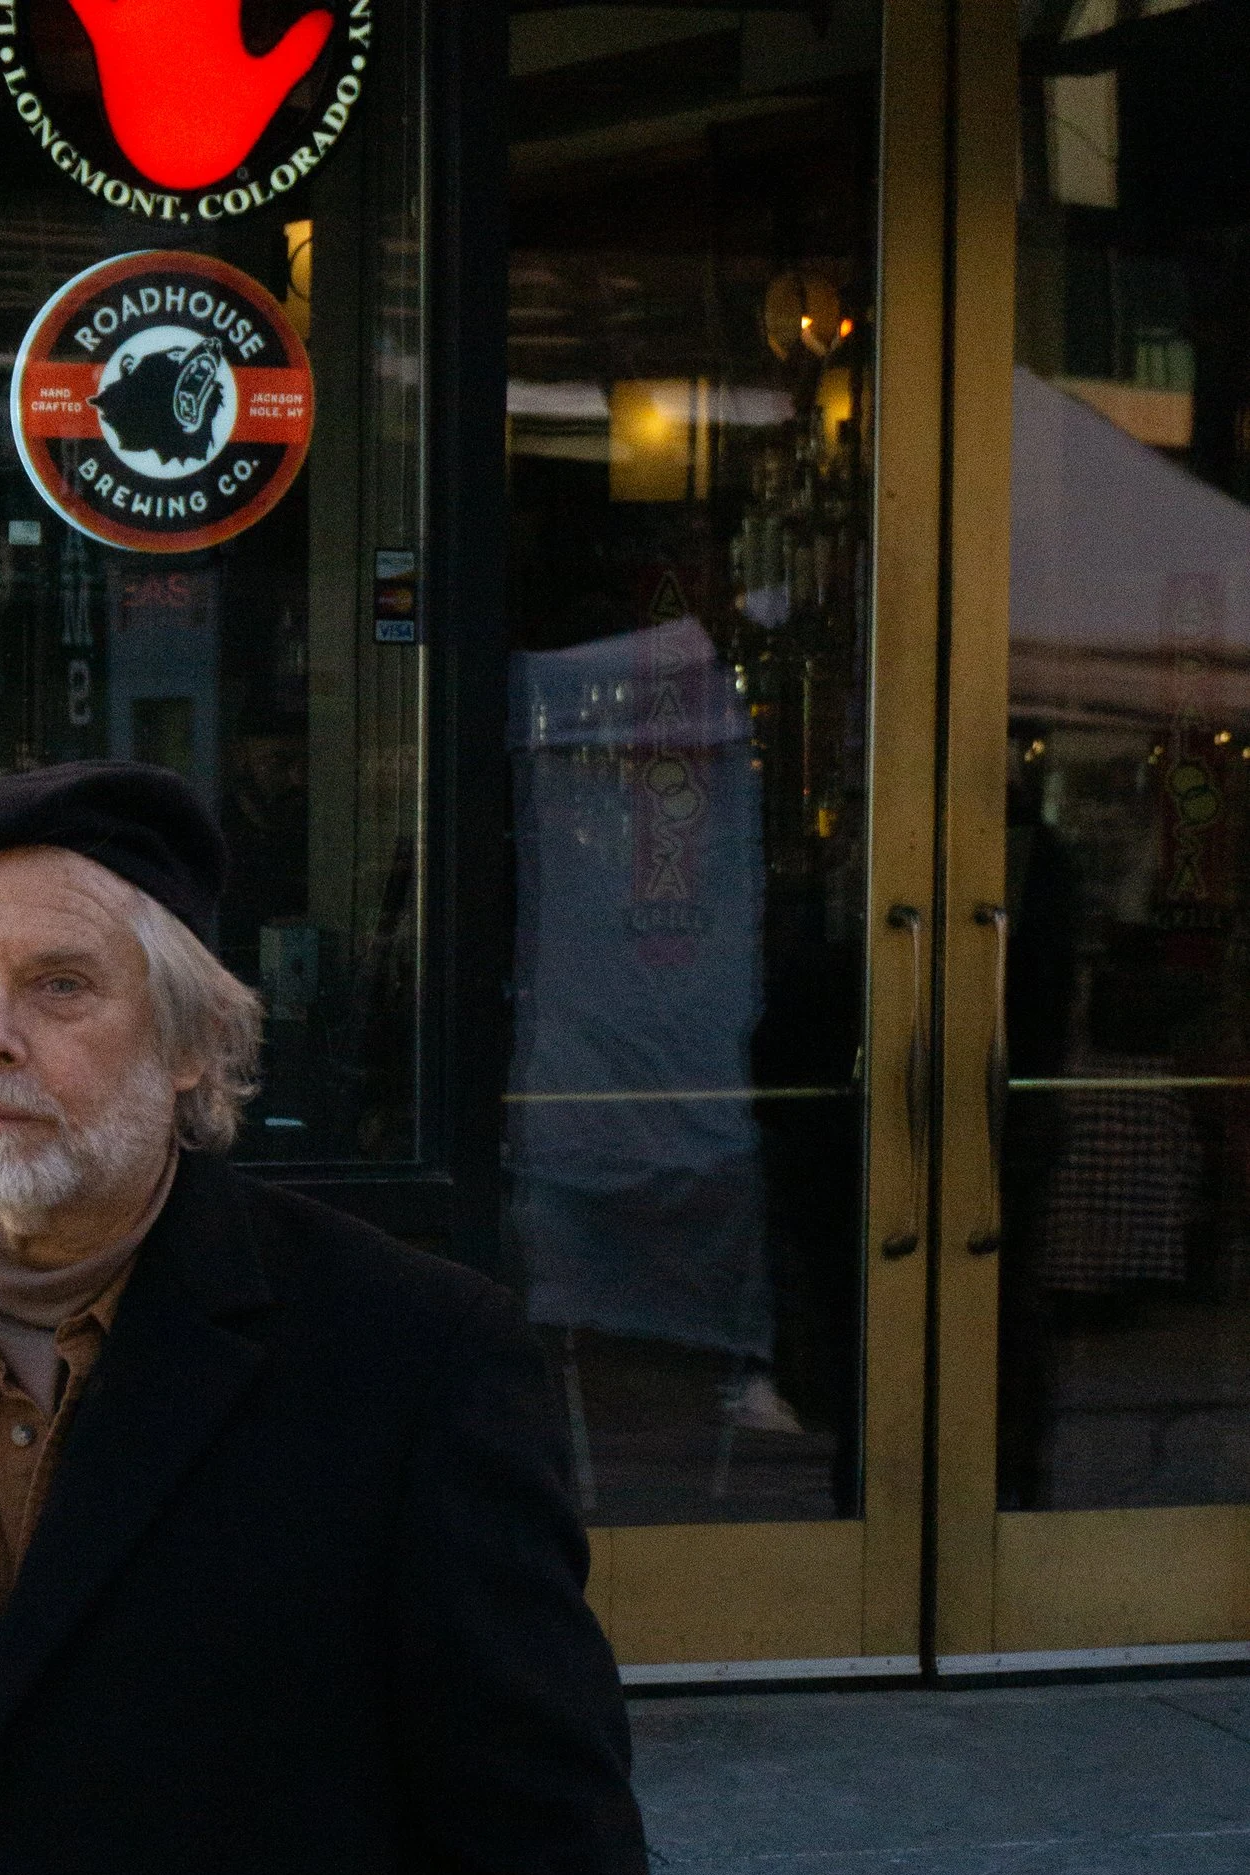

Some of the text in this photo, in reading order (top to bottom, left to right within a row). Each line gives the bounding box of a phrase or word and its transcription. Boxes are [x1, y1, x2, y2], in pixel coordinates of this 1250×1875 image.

[3, 66, 362, 225] LONGMONT, COLORADO
[74, 285, 266, 359] ROADHOUSE
[40, 387, 71, 398] HAND
[250, 392, 303, 404] JACKSON
[31, 401, 83, 413] CRAFTED
[78, 457, 260, 519] BREWING CO.
[379, 624, 412, 638] VISA
